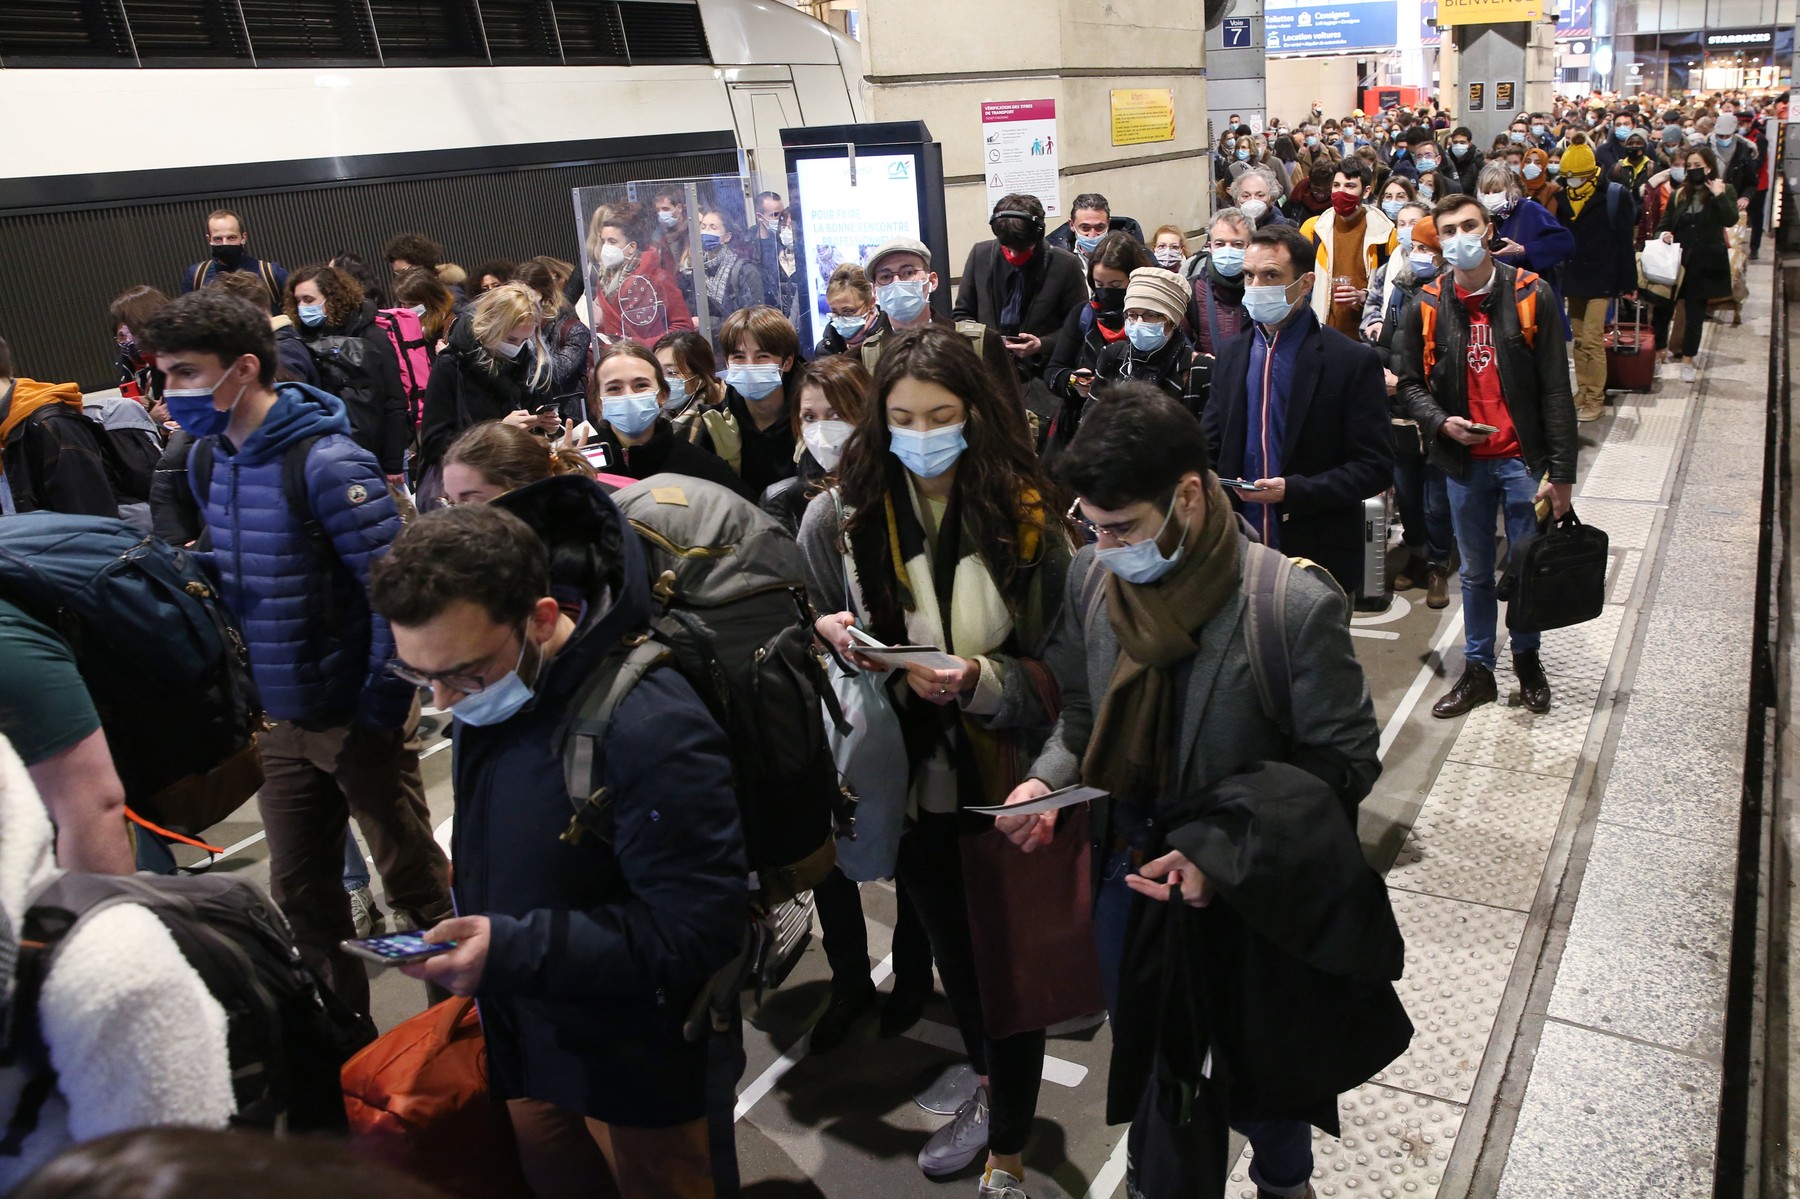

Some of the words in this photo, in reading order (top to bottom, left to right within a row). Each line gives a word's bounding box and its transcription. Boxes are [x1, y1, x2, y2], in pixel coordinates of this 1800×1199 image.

[1265, 15, 1294, 23] Toilettes
[1315, 11, 1350, 20] Consignes
[1231, 28, 1242, 45] 7
[1283, 33, 1312, 41] Location
[1313, 31, 1341, 39] voitures
[1708, 33, 1771, 44] STARBUCKS
[812, 210, 835, 220] POUR
[837, 209, 861, 219] FAIRE
[813, 223, 824, 233] LA
[826, 222, 855, 233] BONNE
[858, 221, 910, 232] RENCONTRE
[822, 236, 901, 247] PROFESSIONNEL
